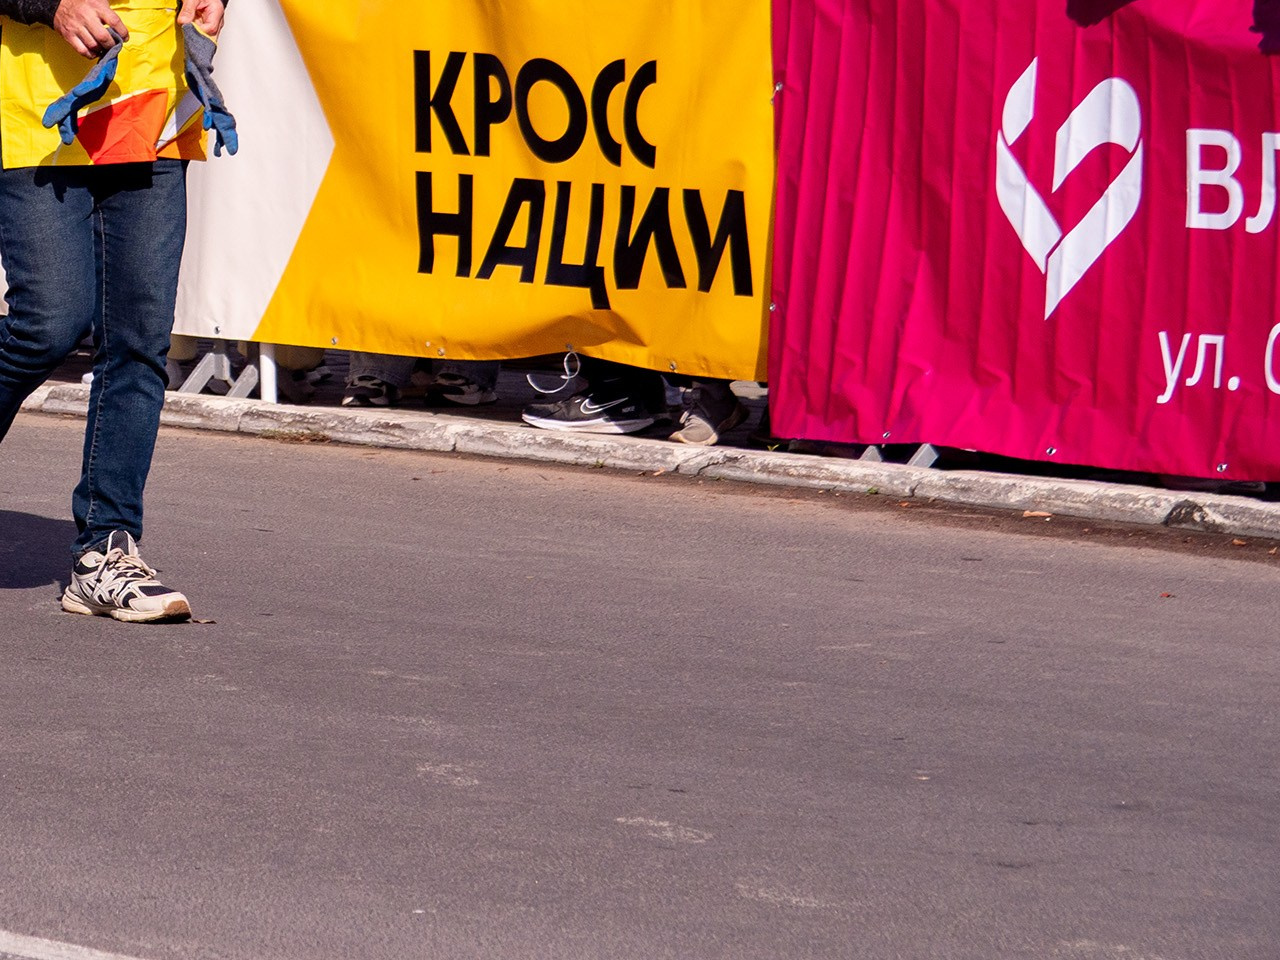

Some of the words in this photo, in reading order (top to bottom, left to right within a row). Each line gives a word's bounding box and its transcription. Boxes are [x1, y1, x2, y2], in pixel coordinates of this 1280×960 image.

[412, 49, 657, 168] КРОСС
[415, 171, 754, 310] НАЦИИ
[1156, 330, 1240, 403] ул.
